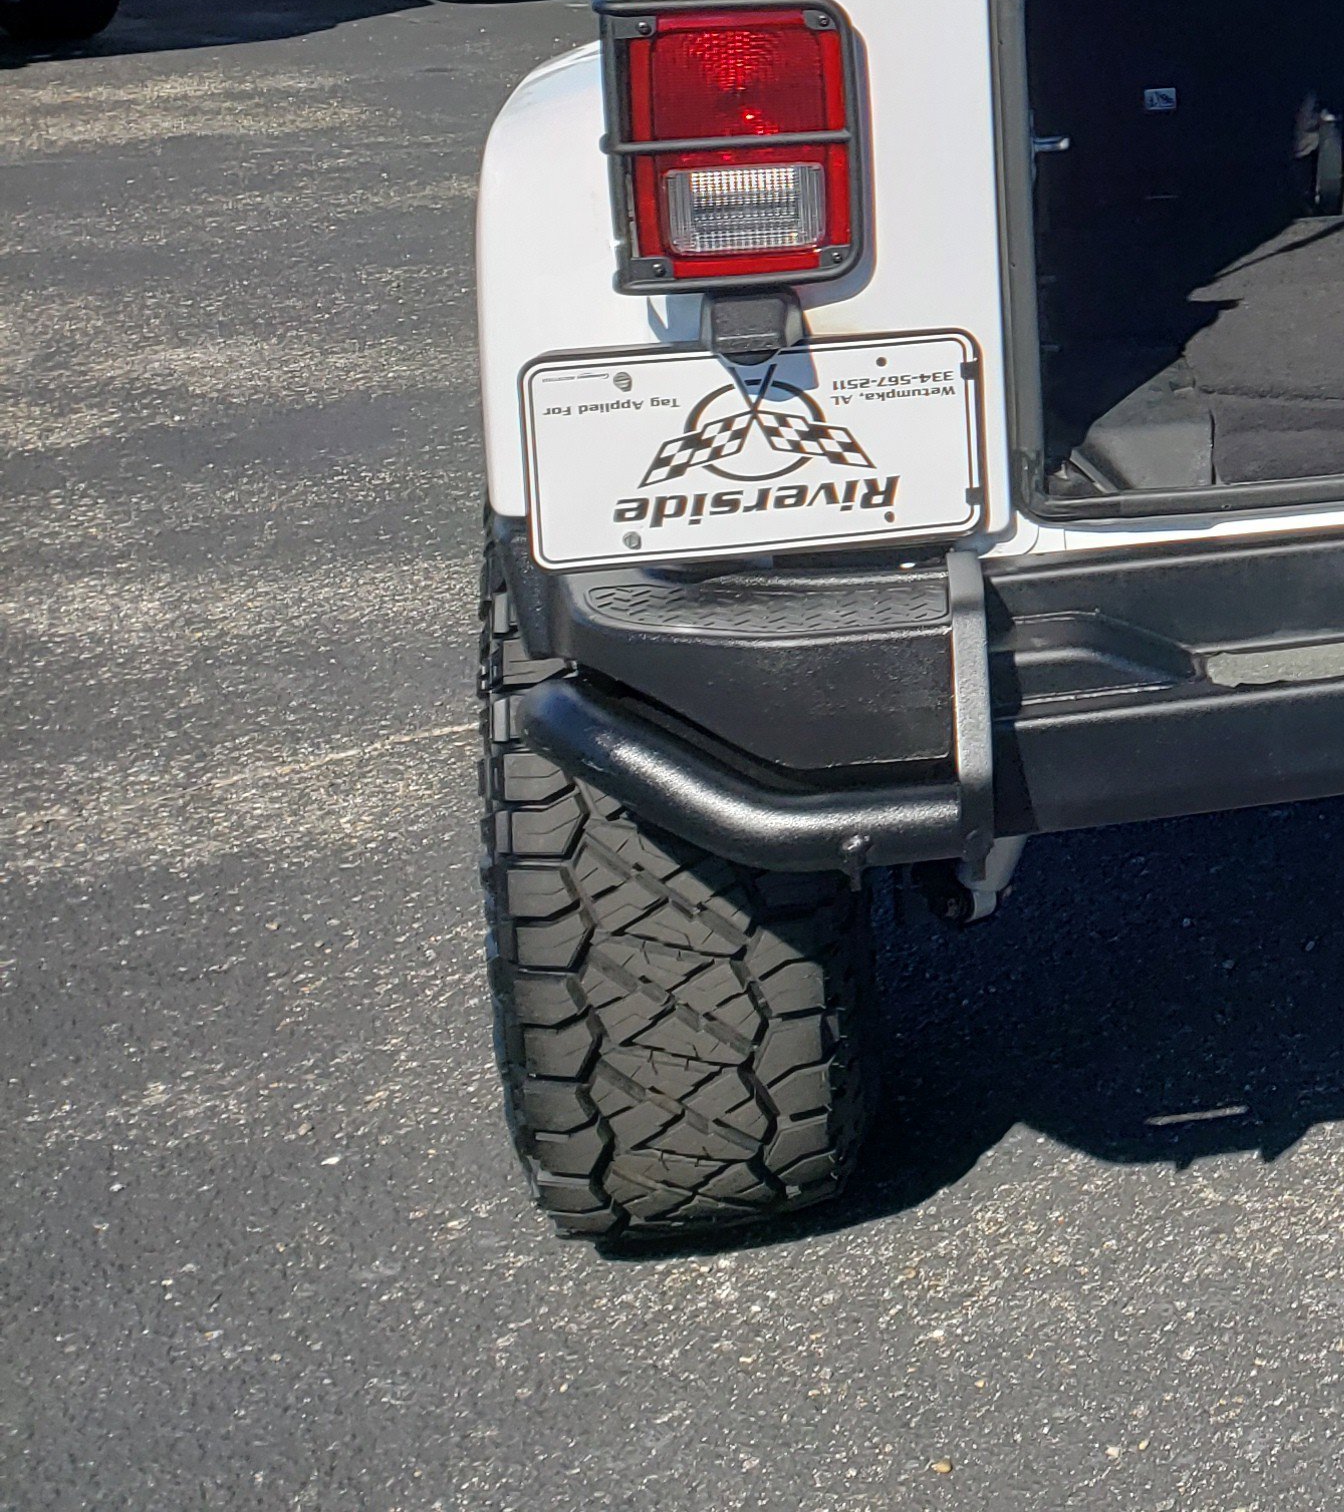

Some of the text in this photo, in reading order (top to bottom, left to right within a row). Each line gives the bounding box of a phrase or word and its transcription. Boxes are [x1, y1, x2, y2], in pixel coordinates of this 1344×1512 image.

[832, 370, 955, 391] 334-567-2511
[542, 396, 681, 416] Tag Applied For
[830, 385, 956, 406] Wetumpka, AL
[613, 475, 900, 528] Riverside
